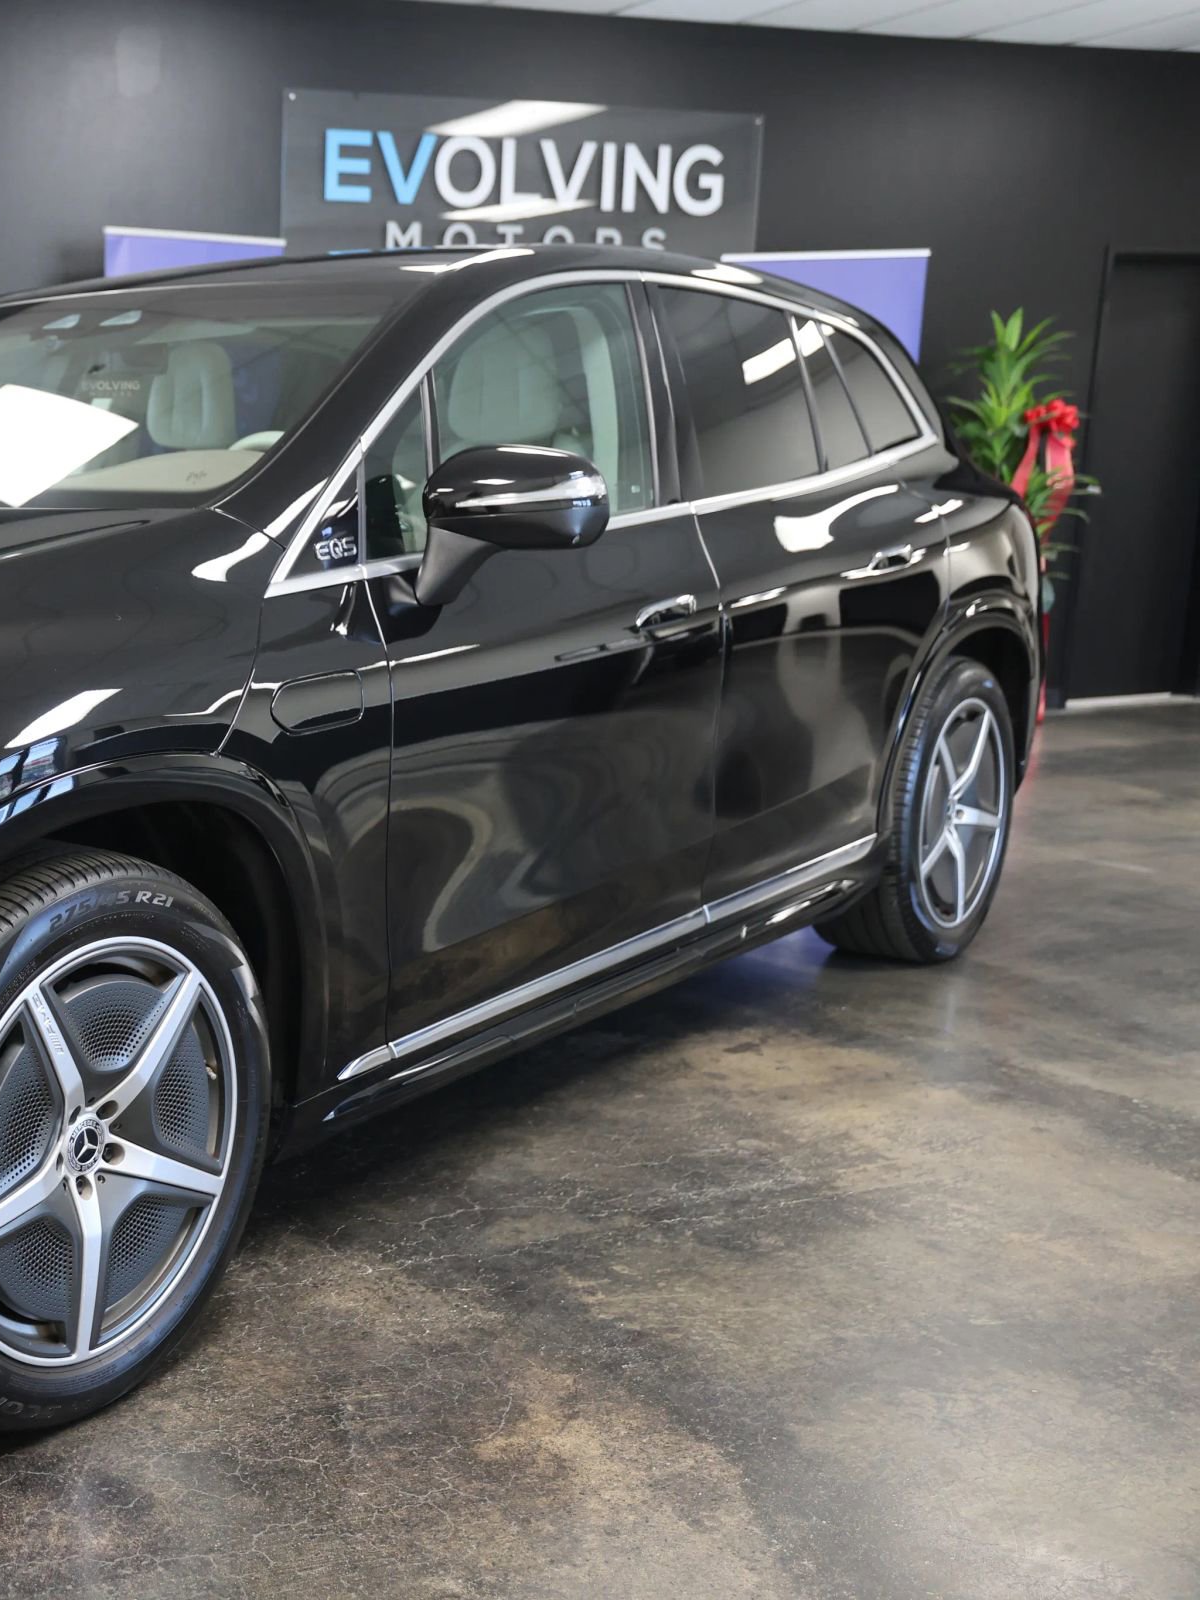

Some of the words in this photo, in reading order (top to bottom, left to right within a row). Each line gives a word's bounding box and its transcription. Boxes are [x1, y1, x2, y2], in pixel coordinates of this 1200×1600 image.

[323, 127, 725, 217] EVOLVING
[314, 536, 357, 560] EQS
[134, 889, 176, 908] R21
